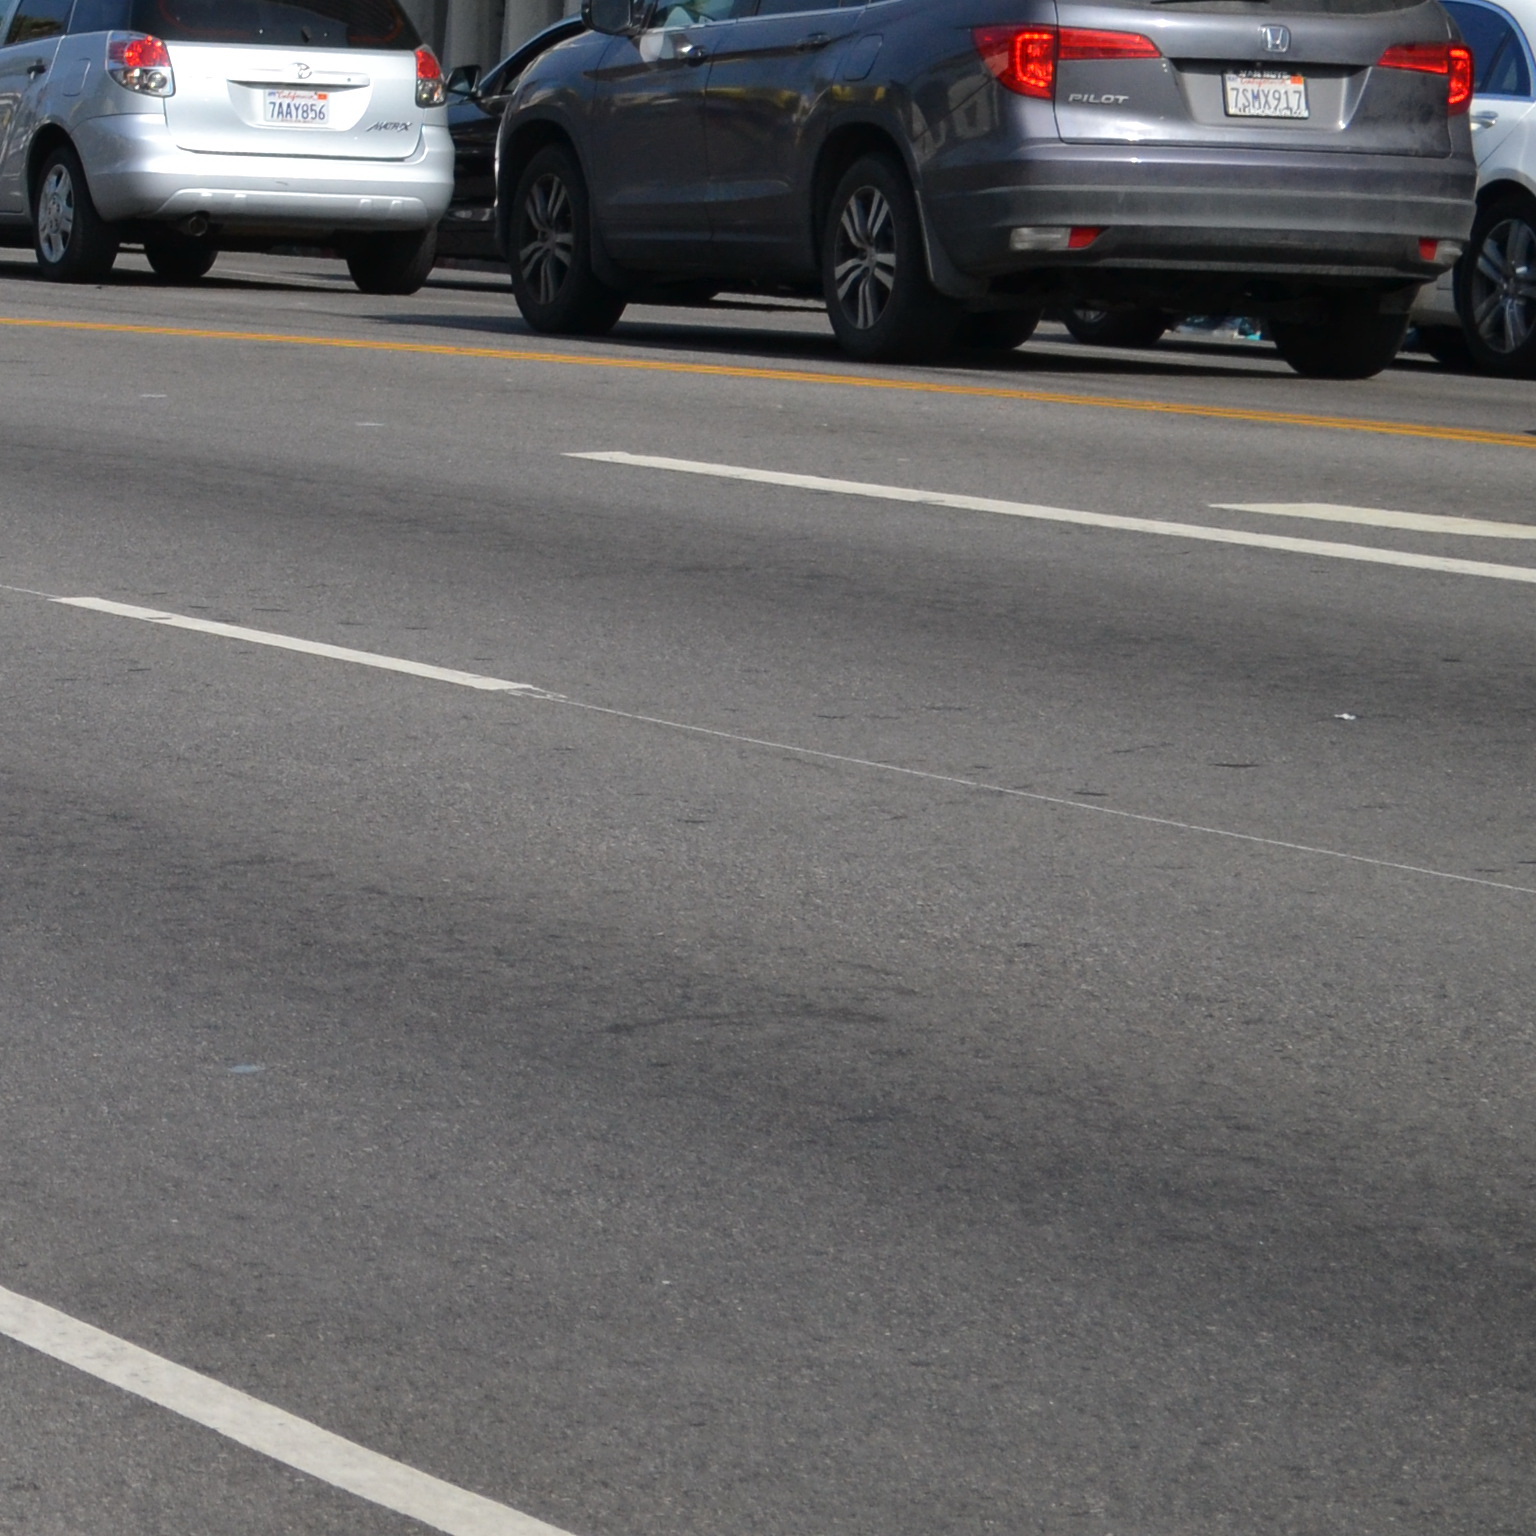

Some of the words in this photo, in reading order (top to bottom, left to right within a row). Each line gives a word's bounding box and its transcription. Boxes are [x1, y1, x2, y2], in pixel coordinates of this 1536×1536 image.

[276, 90, 316, 101] California
[1068, 93, 1129, 104] PILOT
[1230, 87, 1302, 113] 7SMX917
[268, 101, 326, 120] 7AAY856
[366, 121, 412, 133] MATRIX
